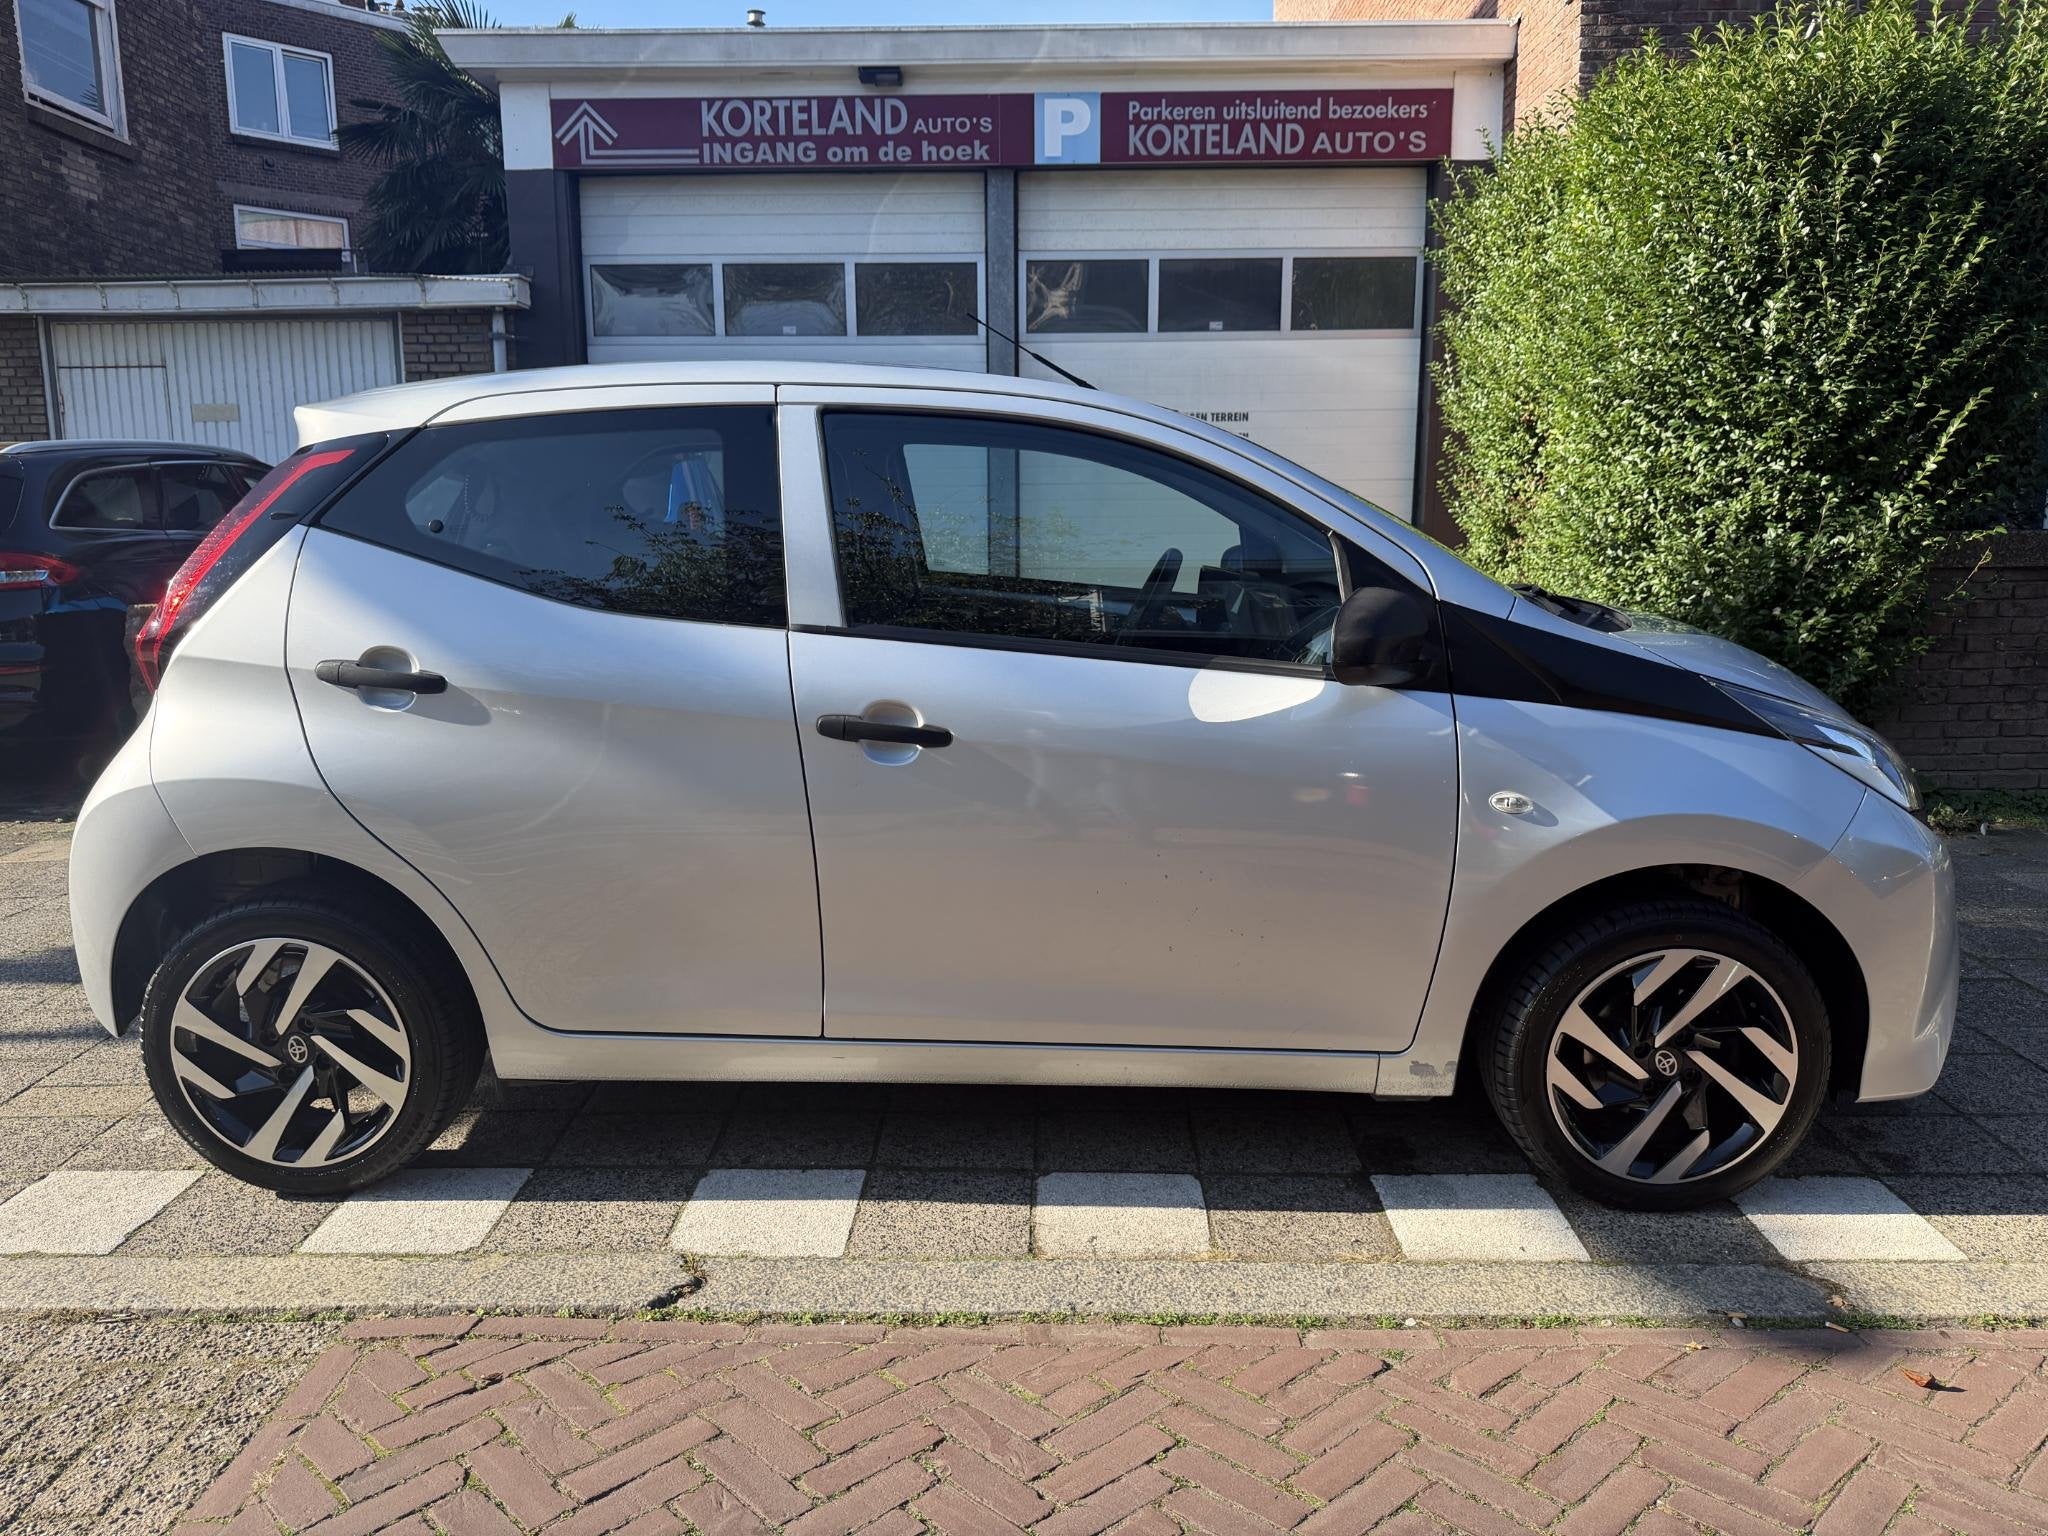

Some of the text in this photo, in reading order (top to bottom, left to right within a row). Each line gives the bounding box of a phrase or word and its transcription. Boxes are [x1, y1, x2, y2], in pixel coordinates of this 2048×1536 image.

[701, 97, 992, 137] KORTELAND AUTO'S
[1128, 96, 1428, 121] Parkeren uitsluitend bezoekers
[1044, 98, 1091, 157] P
[1128, 122, 1427, 156] KORTELAND AUTO'S
[702, 139, 990, 164] INGANG om de hoek
[1211, 411, 1249, 422] TERREIN
